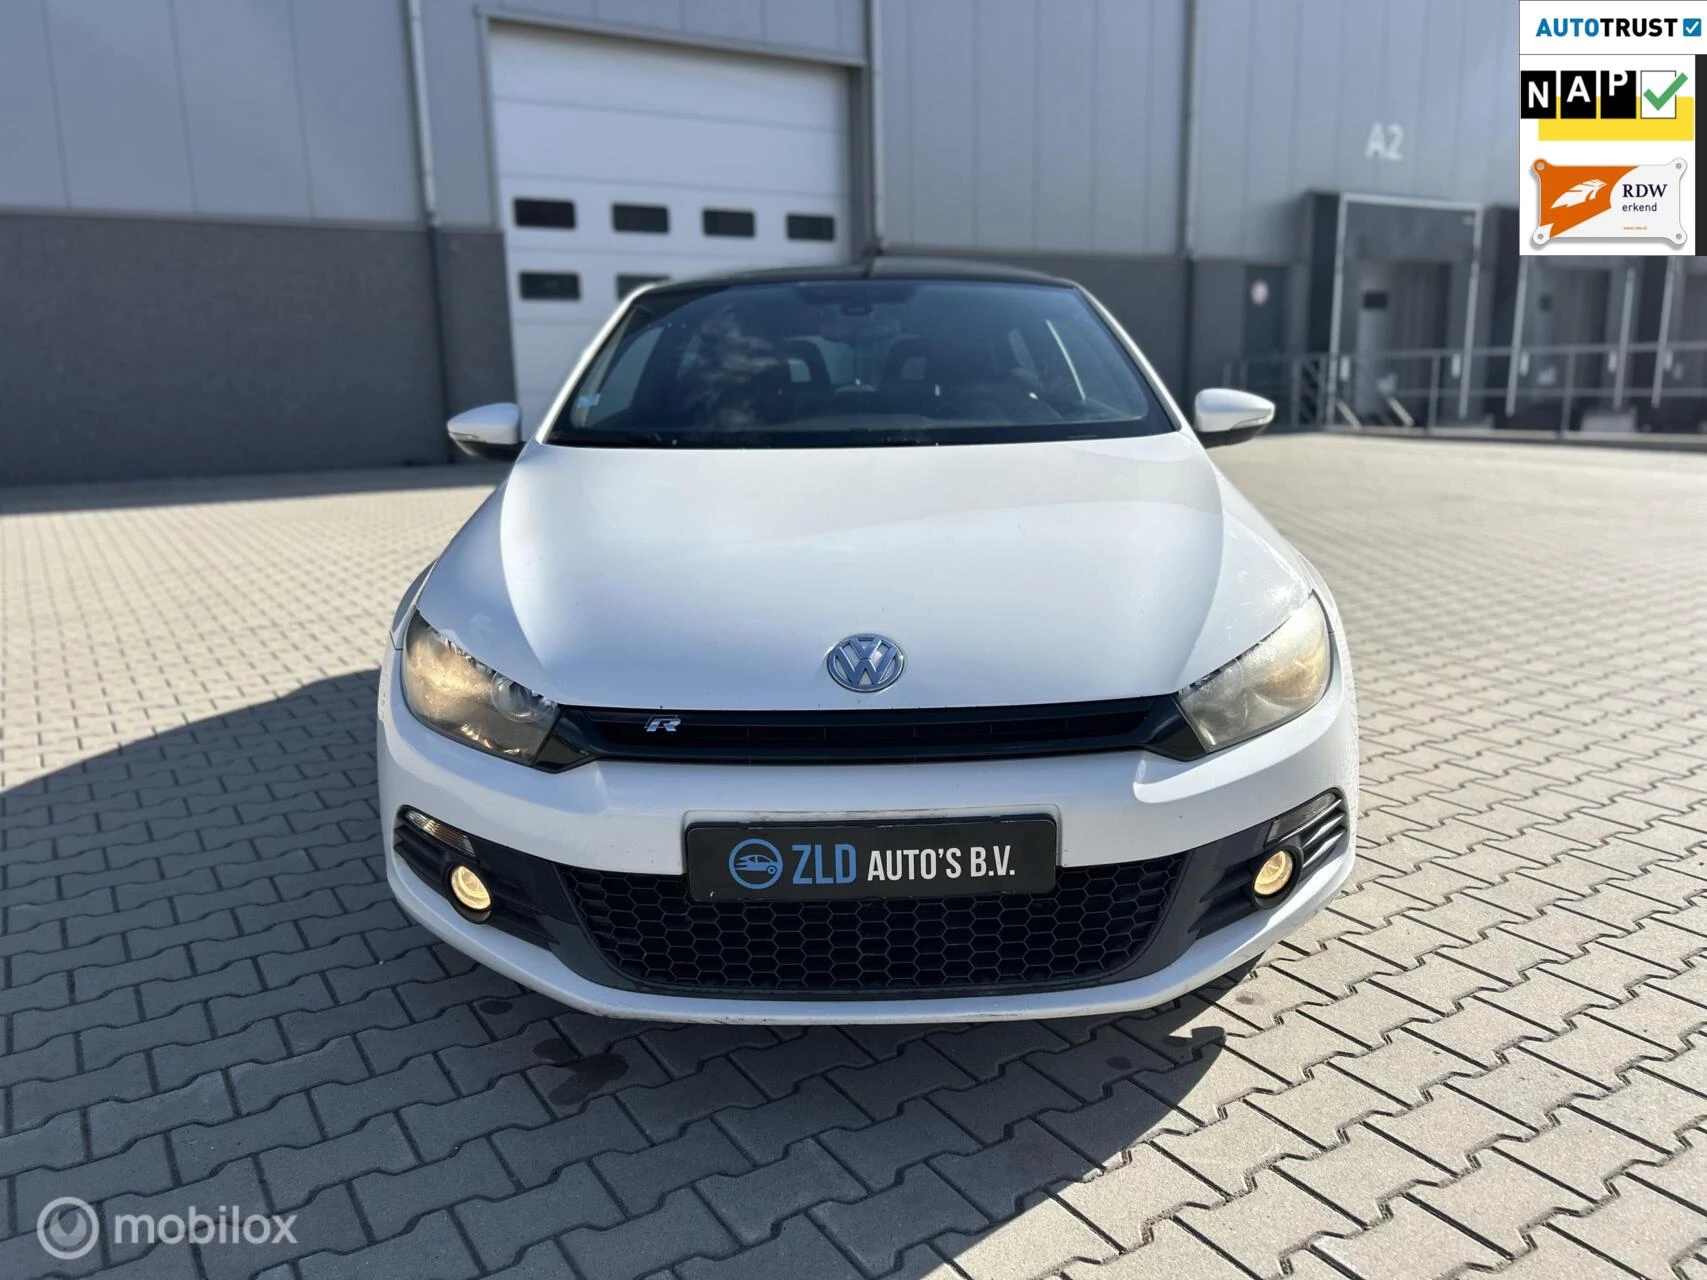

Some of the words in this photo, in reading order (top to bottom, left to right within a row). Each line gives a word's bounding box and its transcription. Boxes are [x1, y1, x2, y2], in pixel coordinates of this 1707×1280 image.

[1365, 122, 1403, 160] A2
[645, 714, 681, 732] R
[792, 844, 857, 885] ZLD
[867, 847, 962, 881] AUTO'S
[970, 845, 1016, 877] B.V.
